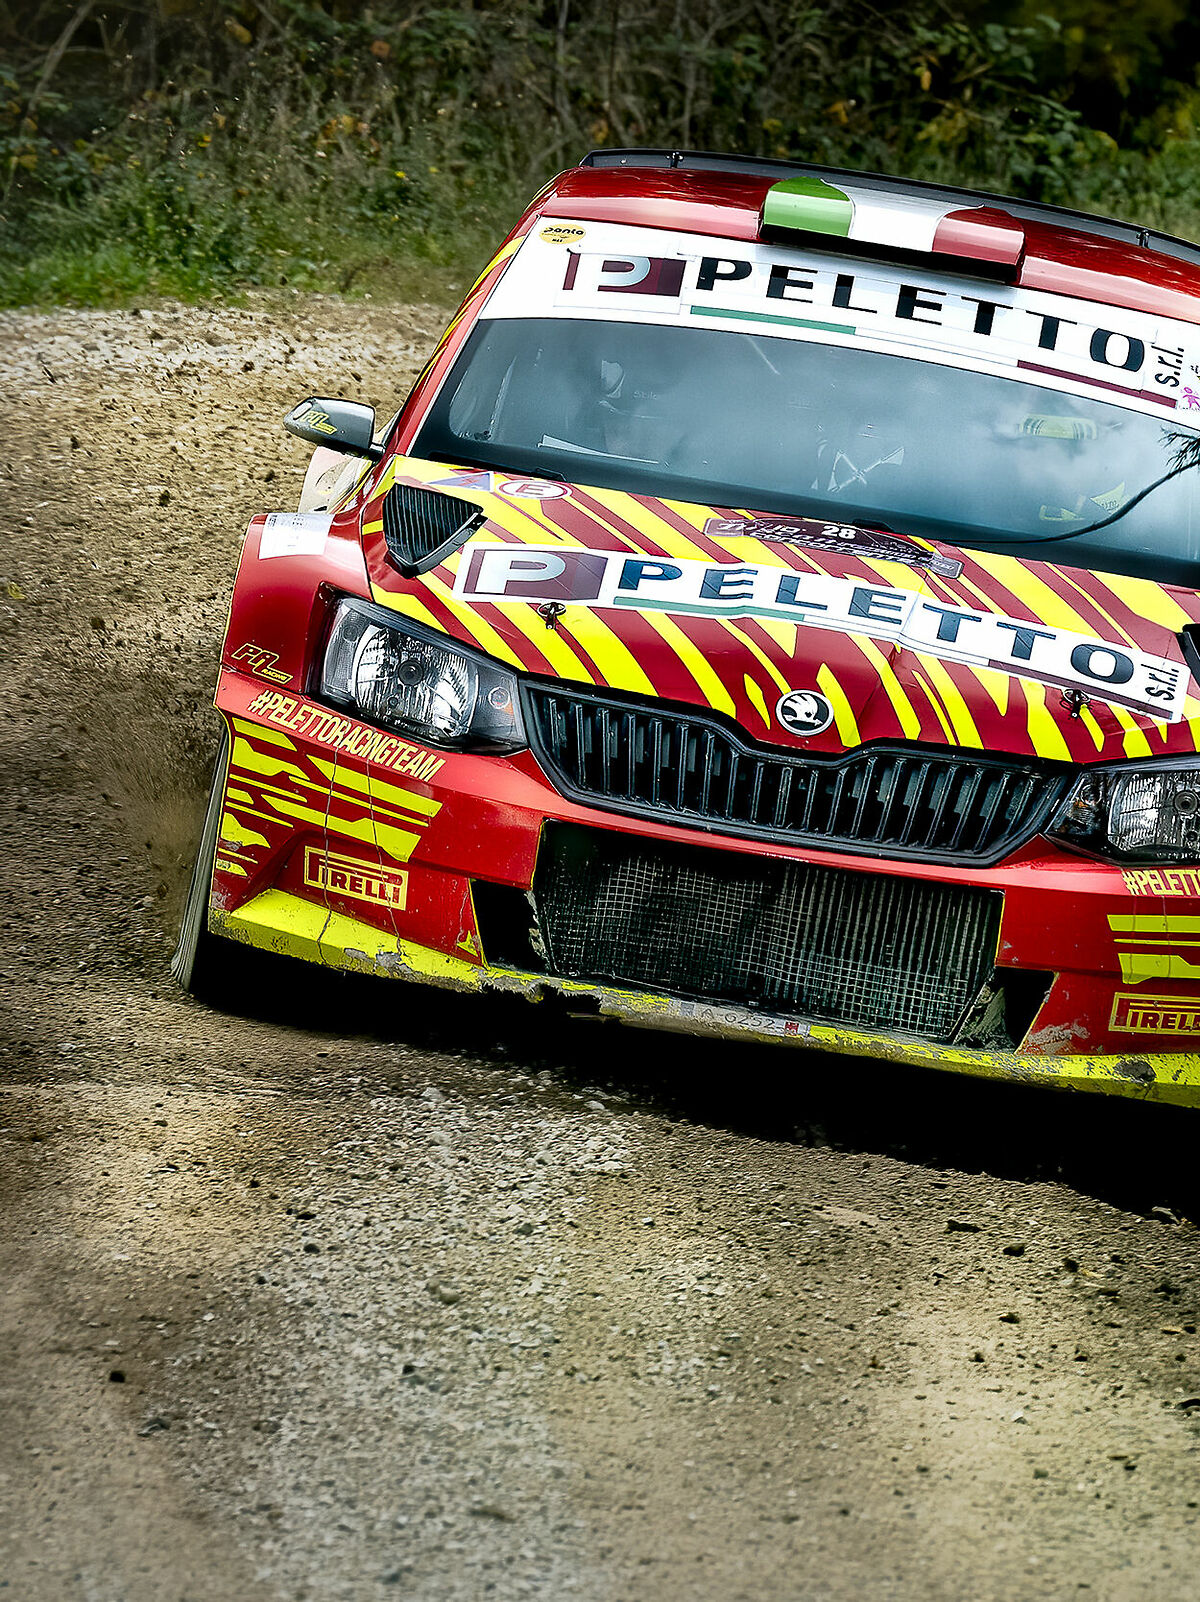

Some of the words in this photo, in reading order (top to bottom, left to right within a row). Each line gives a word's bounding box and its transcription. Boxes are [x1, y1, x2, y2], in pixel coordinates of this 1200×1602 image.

[696, 256, 1145, 373] PELETTO
[821, 525, 857, 540] 28
[618, 558, 1135, 684] PELETTO
[248, 689, 446, 782] #PELETTORACINGTEAM
[307, 850, 404, 905] PIRELLI
